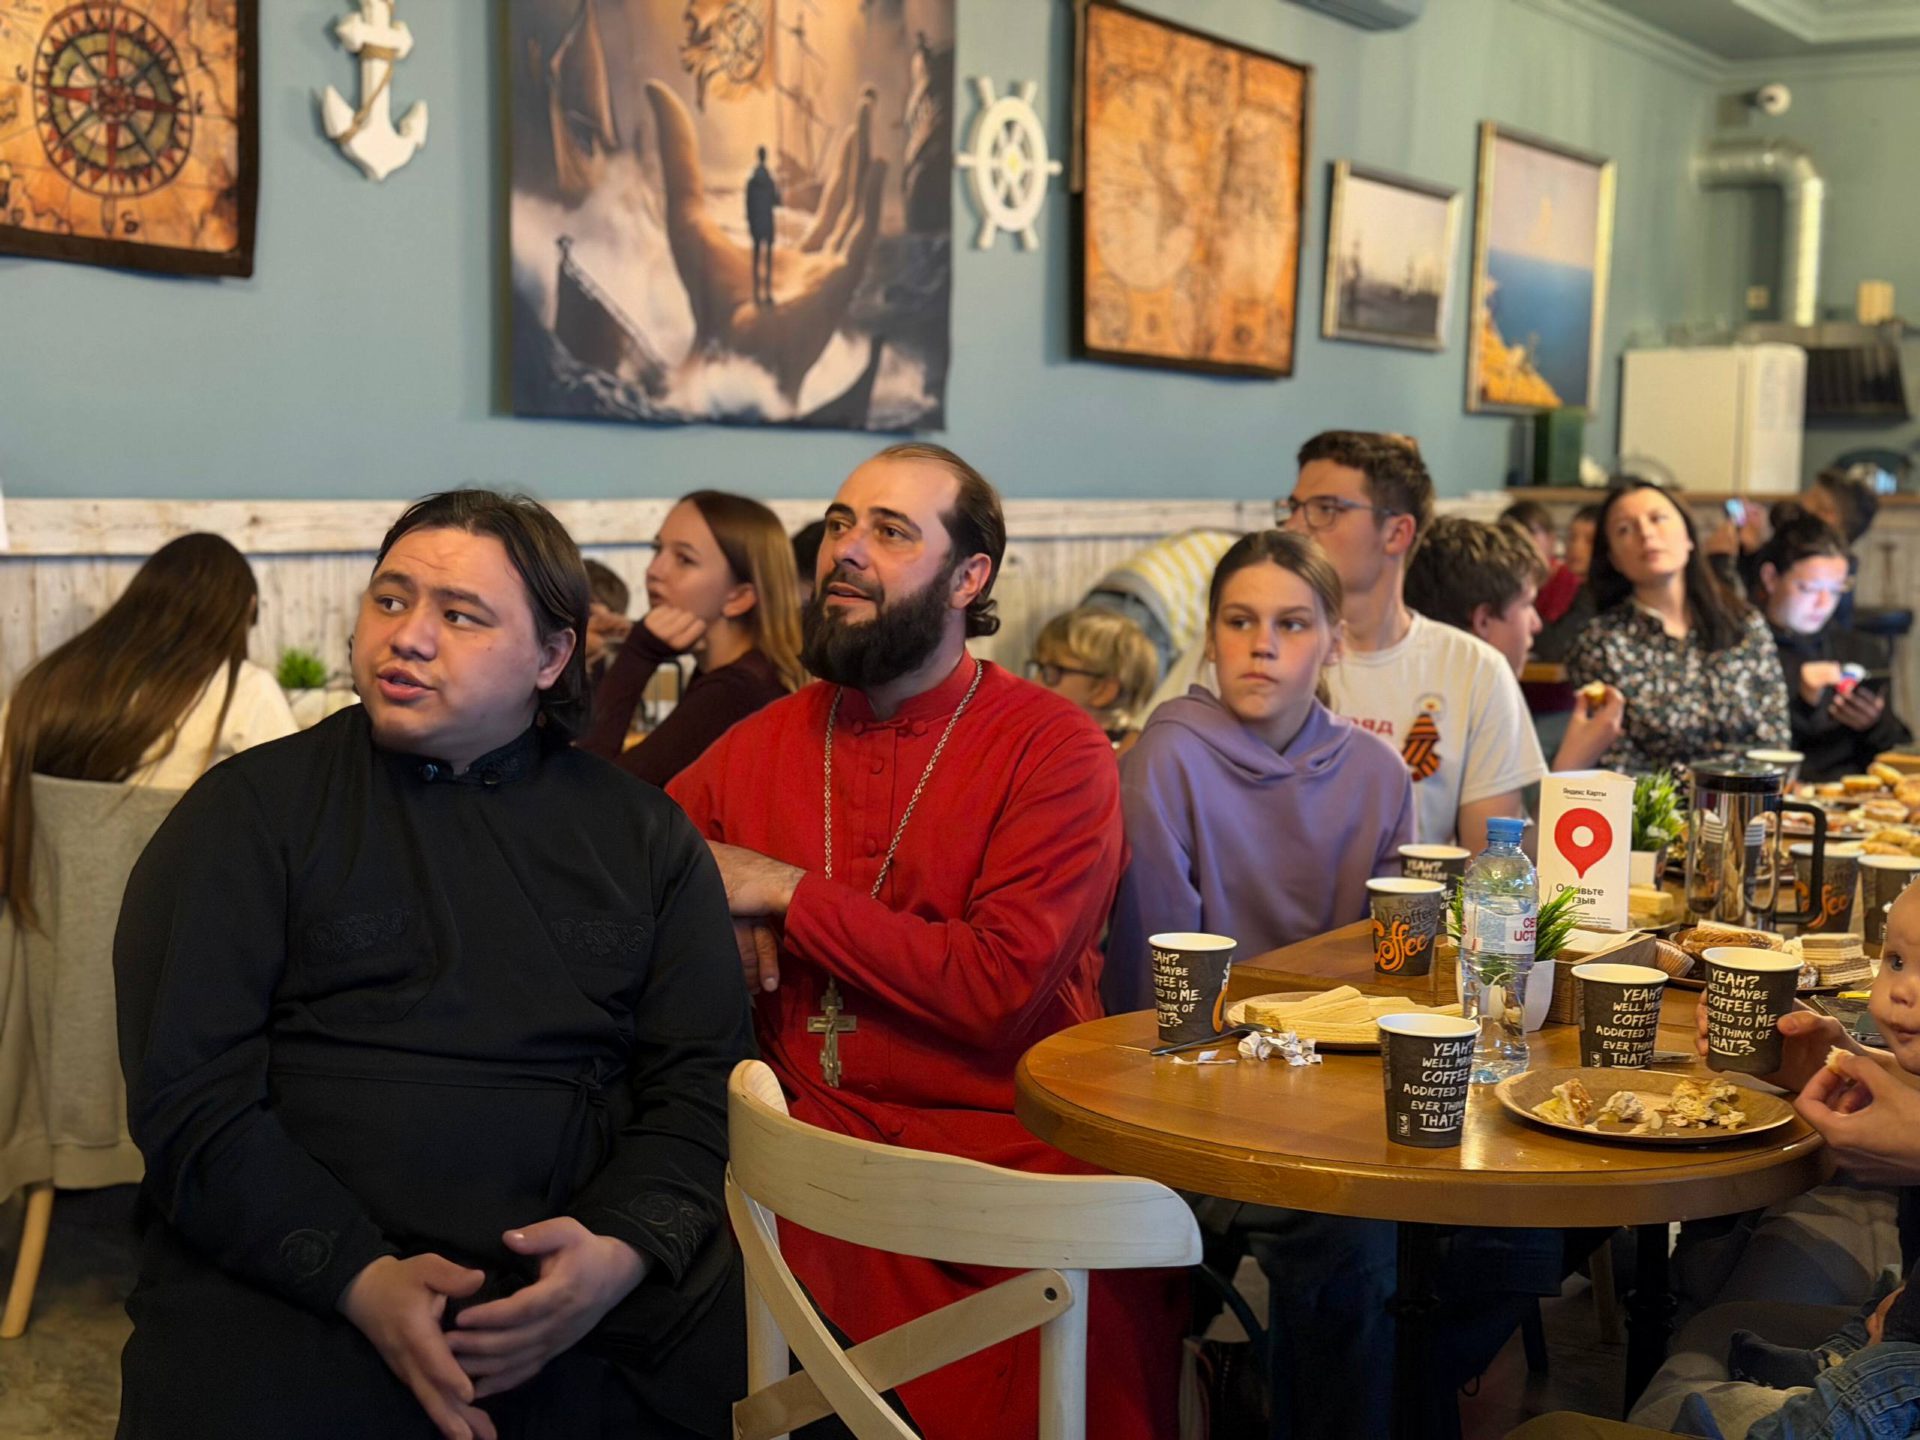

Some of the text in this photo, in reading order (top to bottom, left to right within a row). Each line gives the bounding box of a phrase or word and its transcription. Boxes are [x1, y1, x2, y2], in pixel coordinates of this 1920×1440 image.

[1556, 883, 1604, 897] Оавьте
[1571, 896, 1597, 905] тзыв
[1371, 918, 1429, 971] Coffee
[1152, 950, 1180, 966] EAH?
[1179, 979, 1189, 989] IS
[1711, 968, 1760, 989] YEAH?
[1166, 990, 1178, 1000] TO
[1730, 988, 1769, 1000] MAYBE
[1181, 1003, 1196, 1013] OF
[1612, 1002, 1642, 1012] WELL
[1708, 993, 1767, 1014] COFFEE IS
[1612, 1012, 1657, 1027] COFFEE
[1737, 1016, 1753, 1027] TO
[1755, 1014, 1778, 1028] ME
[1595, 1024, 1646, 1039] ADDICTED
[1721, 1026, 1754, 1040] THINK
[1756, 1029, 1772, 1040] OF
[1602, 1040, 1631, 1052] EVER
[1422, 1057, 1454, 1068] WELL
[1421, 1068, 1468, 1085] COFFEE
[1403, 1083, 1457, 1098] ADDICTED
[1410, 1100, 1440, 1113] EVER
